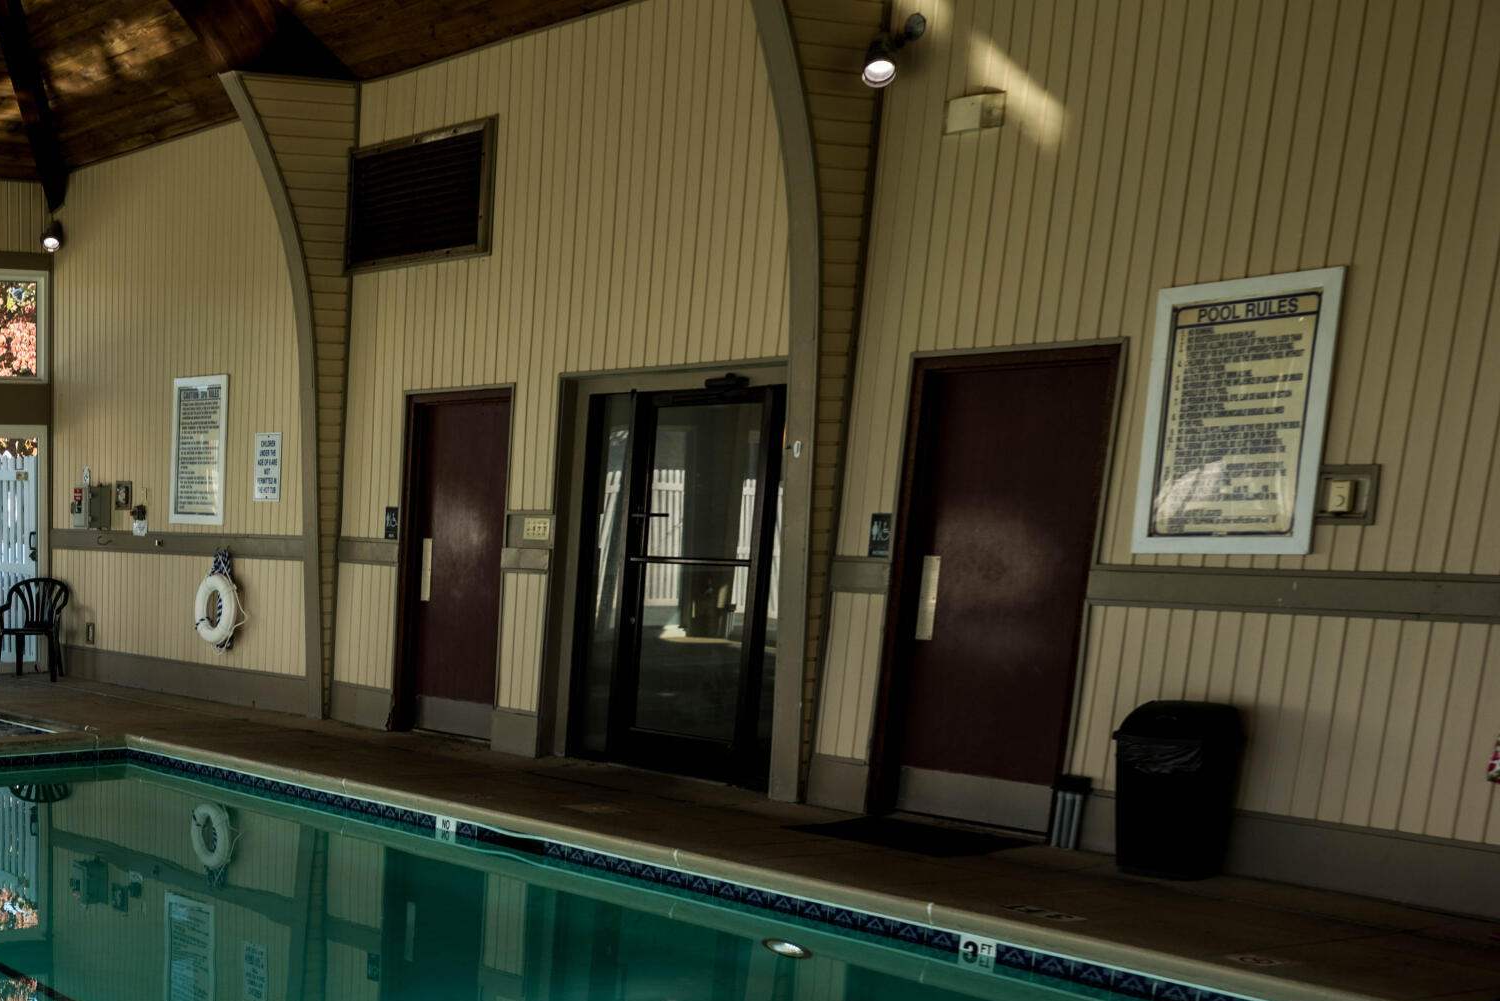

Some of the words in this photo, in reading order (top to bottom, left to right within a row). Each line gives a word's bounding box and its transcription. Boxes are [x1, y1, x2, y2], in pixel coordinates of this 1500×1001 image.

[1197, 303, 1241, 323] POOL
[1245, 297, 1299, 317] RULES
[441, 818, 451, 830] NO
[980, 943, 993, 955] FT
